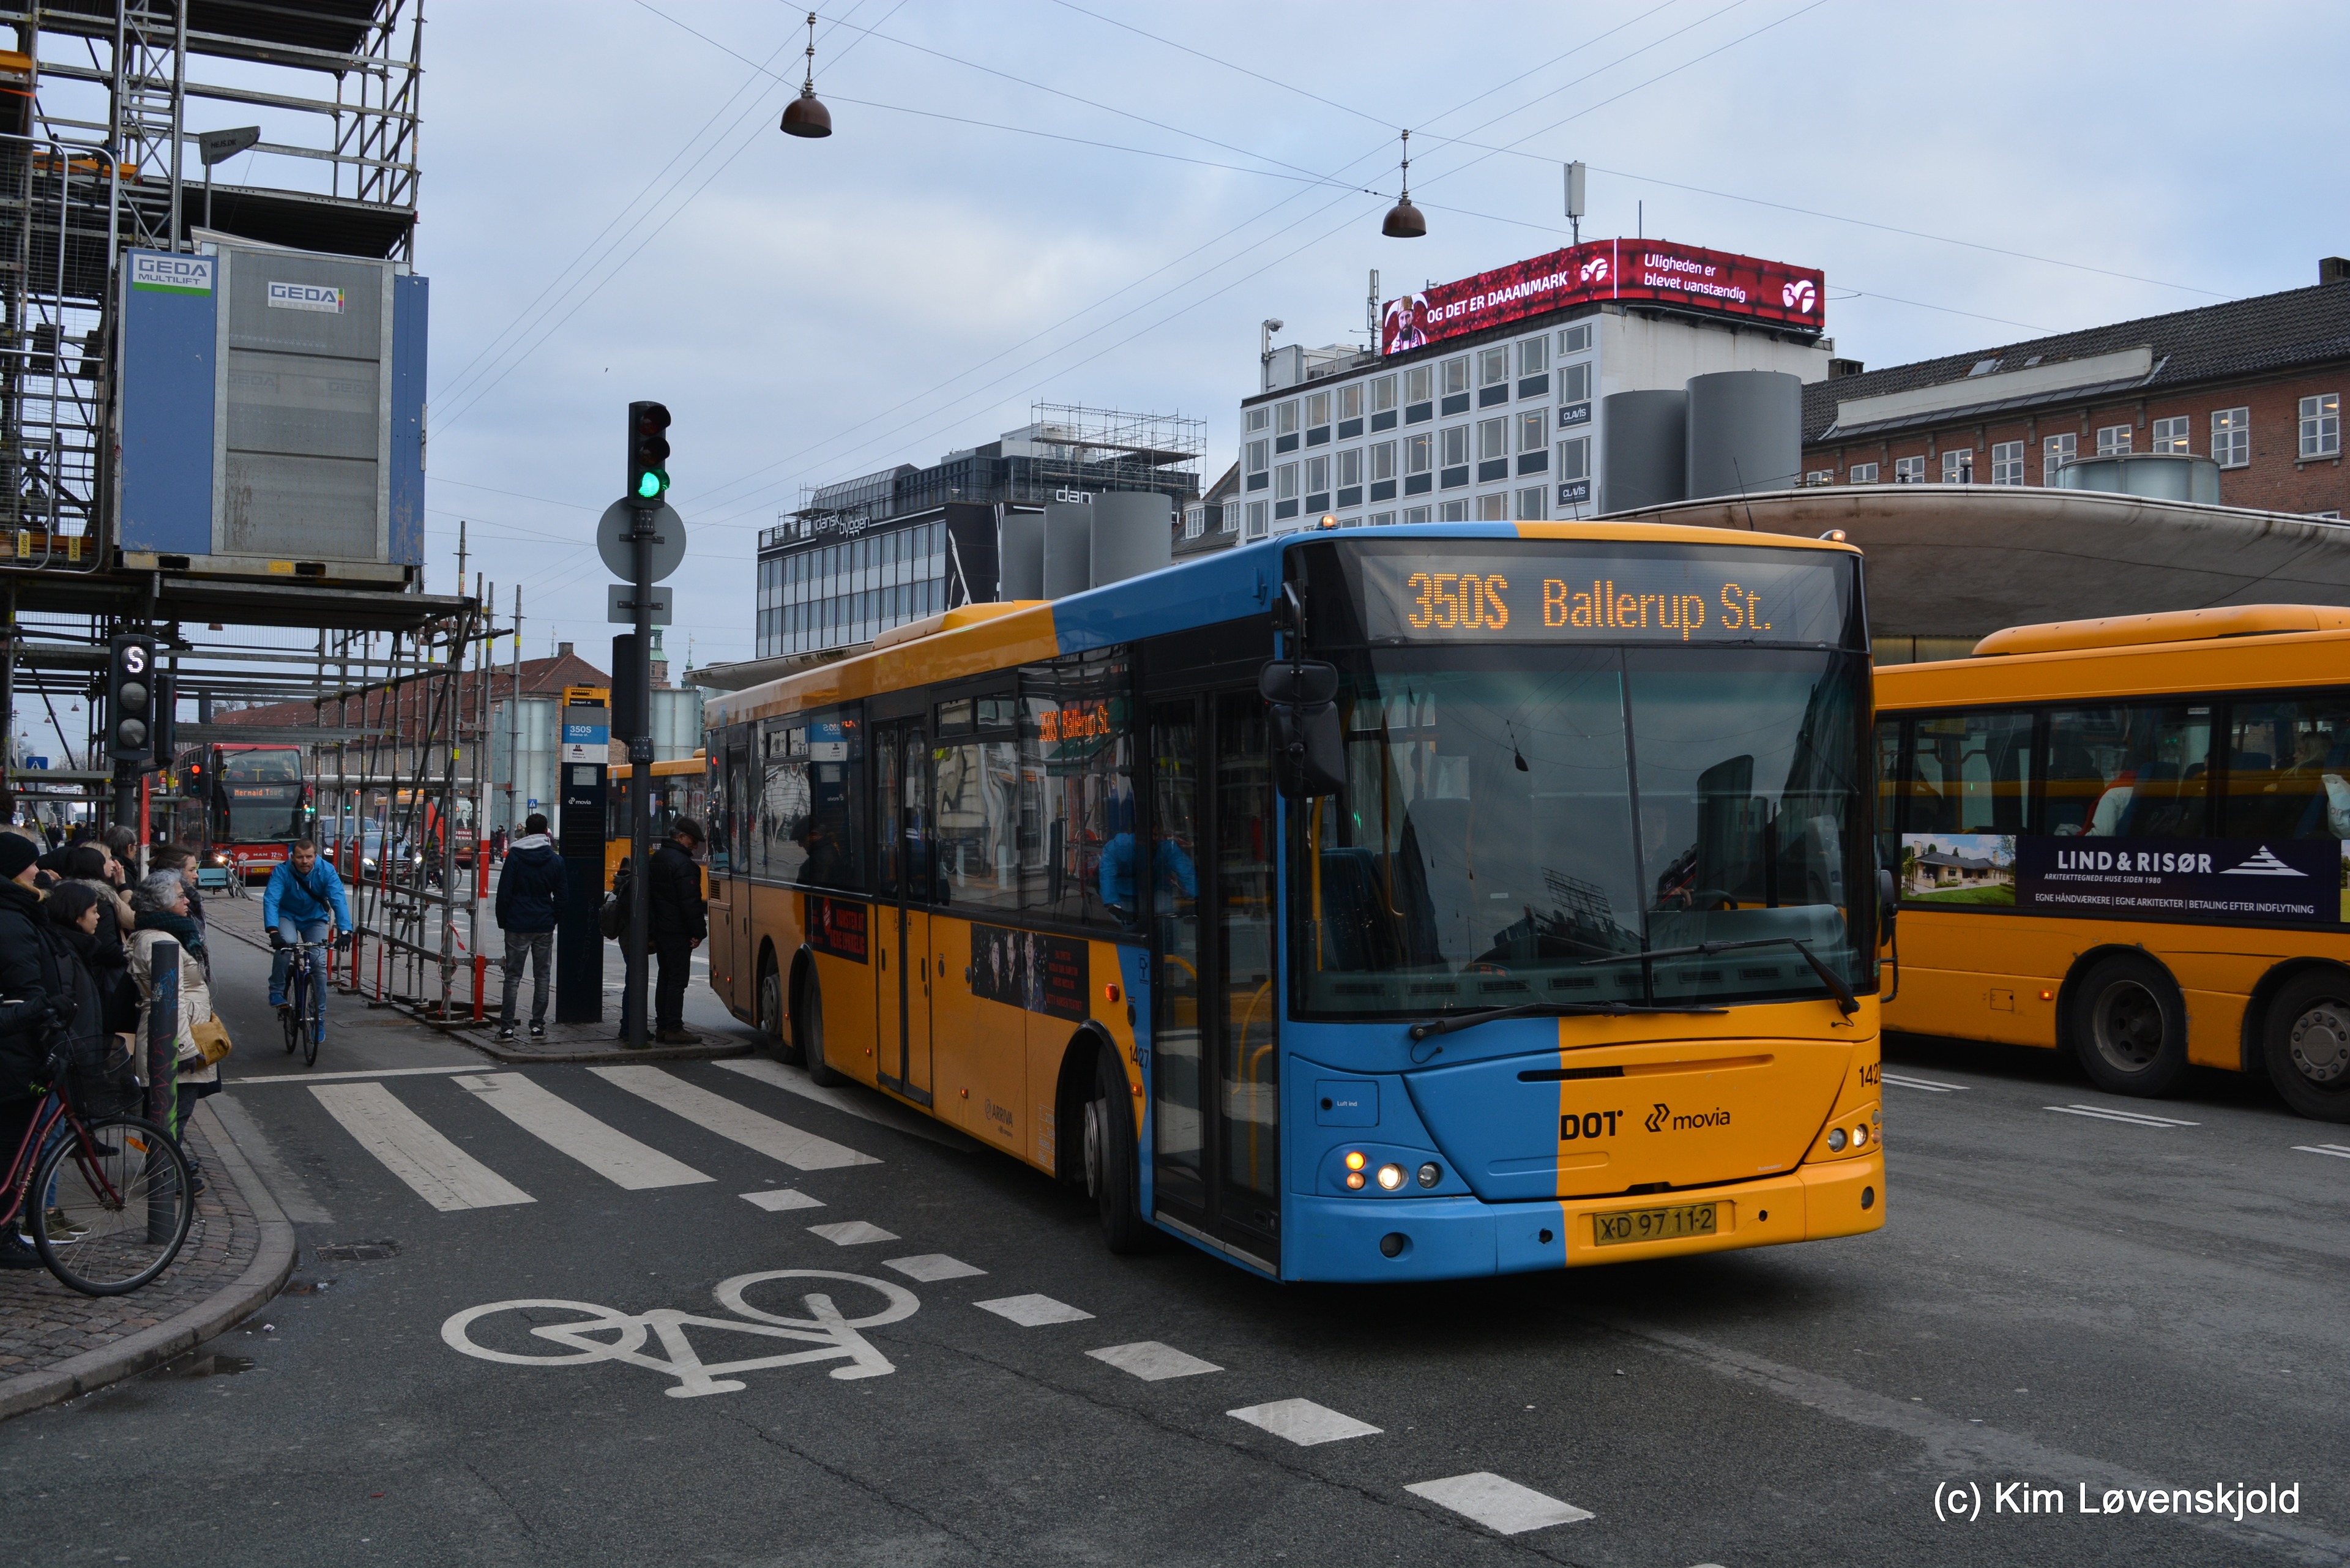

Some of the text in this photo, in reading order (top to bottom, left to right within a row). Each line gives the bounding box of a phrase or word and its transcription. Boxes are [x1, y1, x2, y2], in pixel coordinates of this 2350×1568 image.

[138, 259, 207, 277] GEDA
[1644, 253, 1716, 276] Uligheden er
[138, 274, 201, 285] MULTILIFT
[1644, 272, 1746, 304] blevet uanstændig
[270, 285, 337, 303] GEDA
[1427, 271, 1567, 324] OG DET ER DAAANMARK
[275, 302, 333, 312] ORIGINAL
[816, 509, 840, 531] dansk
[1408, 573, 1771, 641] 350S Ballerup St.
[127, 646, 144, 673] S
[2058, 851, 2212, 873] LIND & RISØR
[2044, 873, 2103, 882] ARKITEKTTEGNEDE
[2055, 892, 2111, 905] HÅNDVÆRKERE
[2116, 897, 2135, 906] EGNE
[2136, 898, 2184, 908] ARKITEKTER
[2189, 900, 2228, 910] BETALING
[2229, 902, 2255, 911] EFTER
[2256, 903, 2314, 914] INDFLYTNING
[1129, 1044, 1149, 1069] 1427
[991, 1104, 1013, 1128] ARRIVA
[1561, 1110, 1624, 1140] DOT
[1673, 1107, 1731, 1130] movia
[1600, 1217, 1632, 1241] XD
[1639, 1213, 1666, 1236] 97
